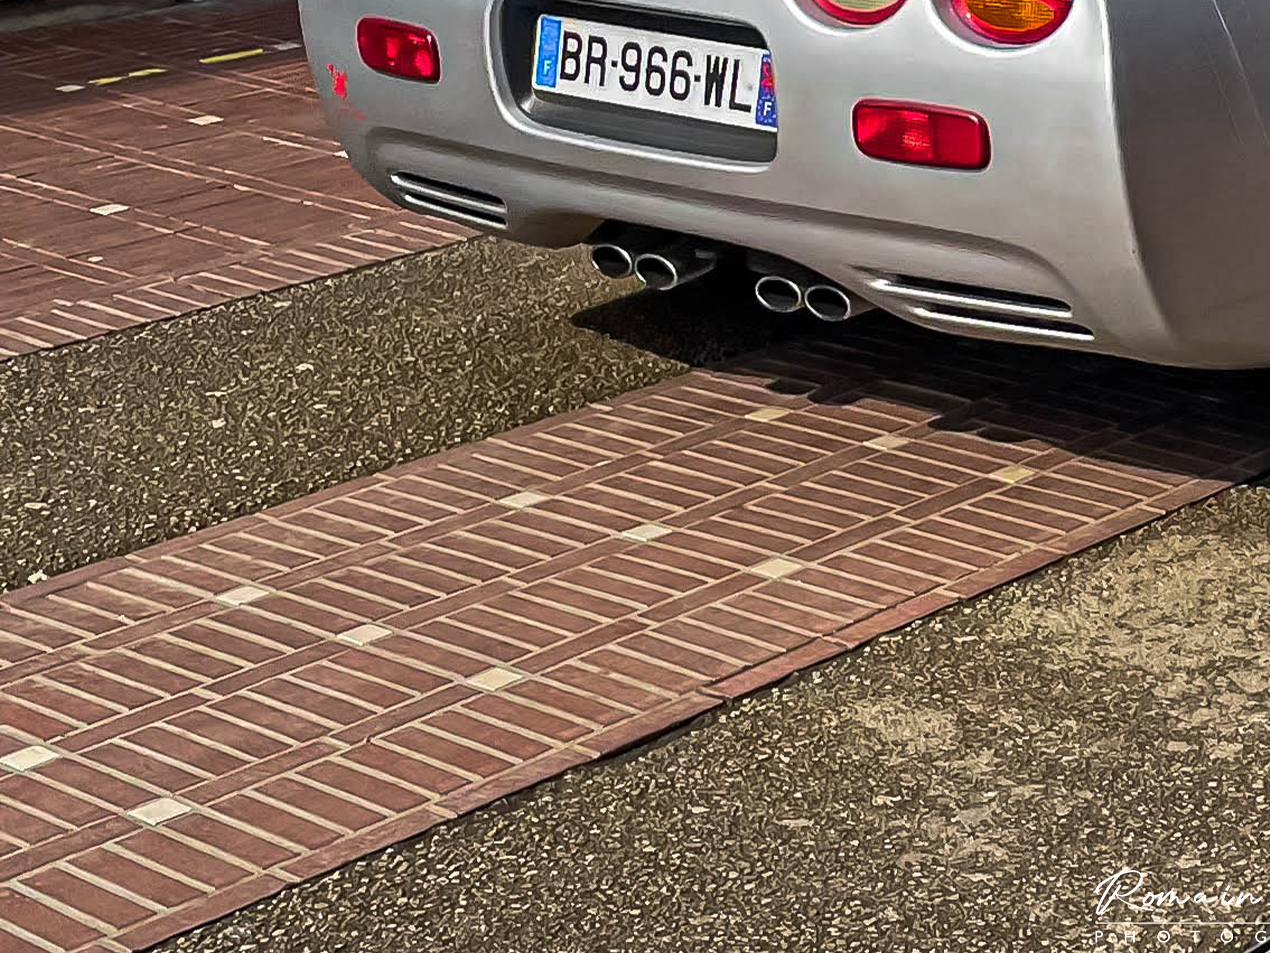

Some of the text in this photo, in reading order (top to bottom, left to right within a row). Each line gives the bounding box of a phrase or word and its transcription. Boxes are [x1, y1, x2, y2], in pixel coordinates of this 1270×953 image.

[543, 59, 552, 75] F
[559, 30, 753, 114] BR-966-WL
[762, 101, 773, 117] F
